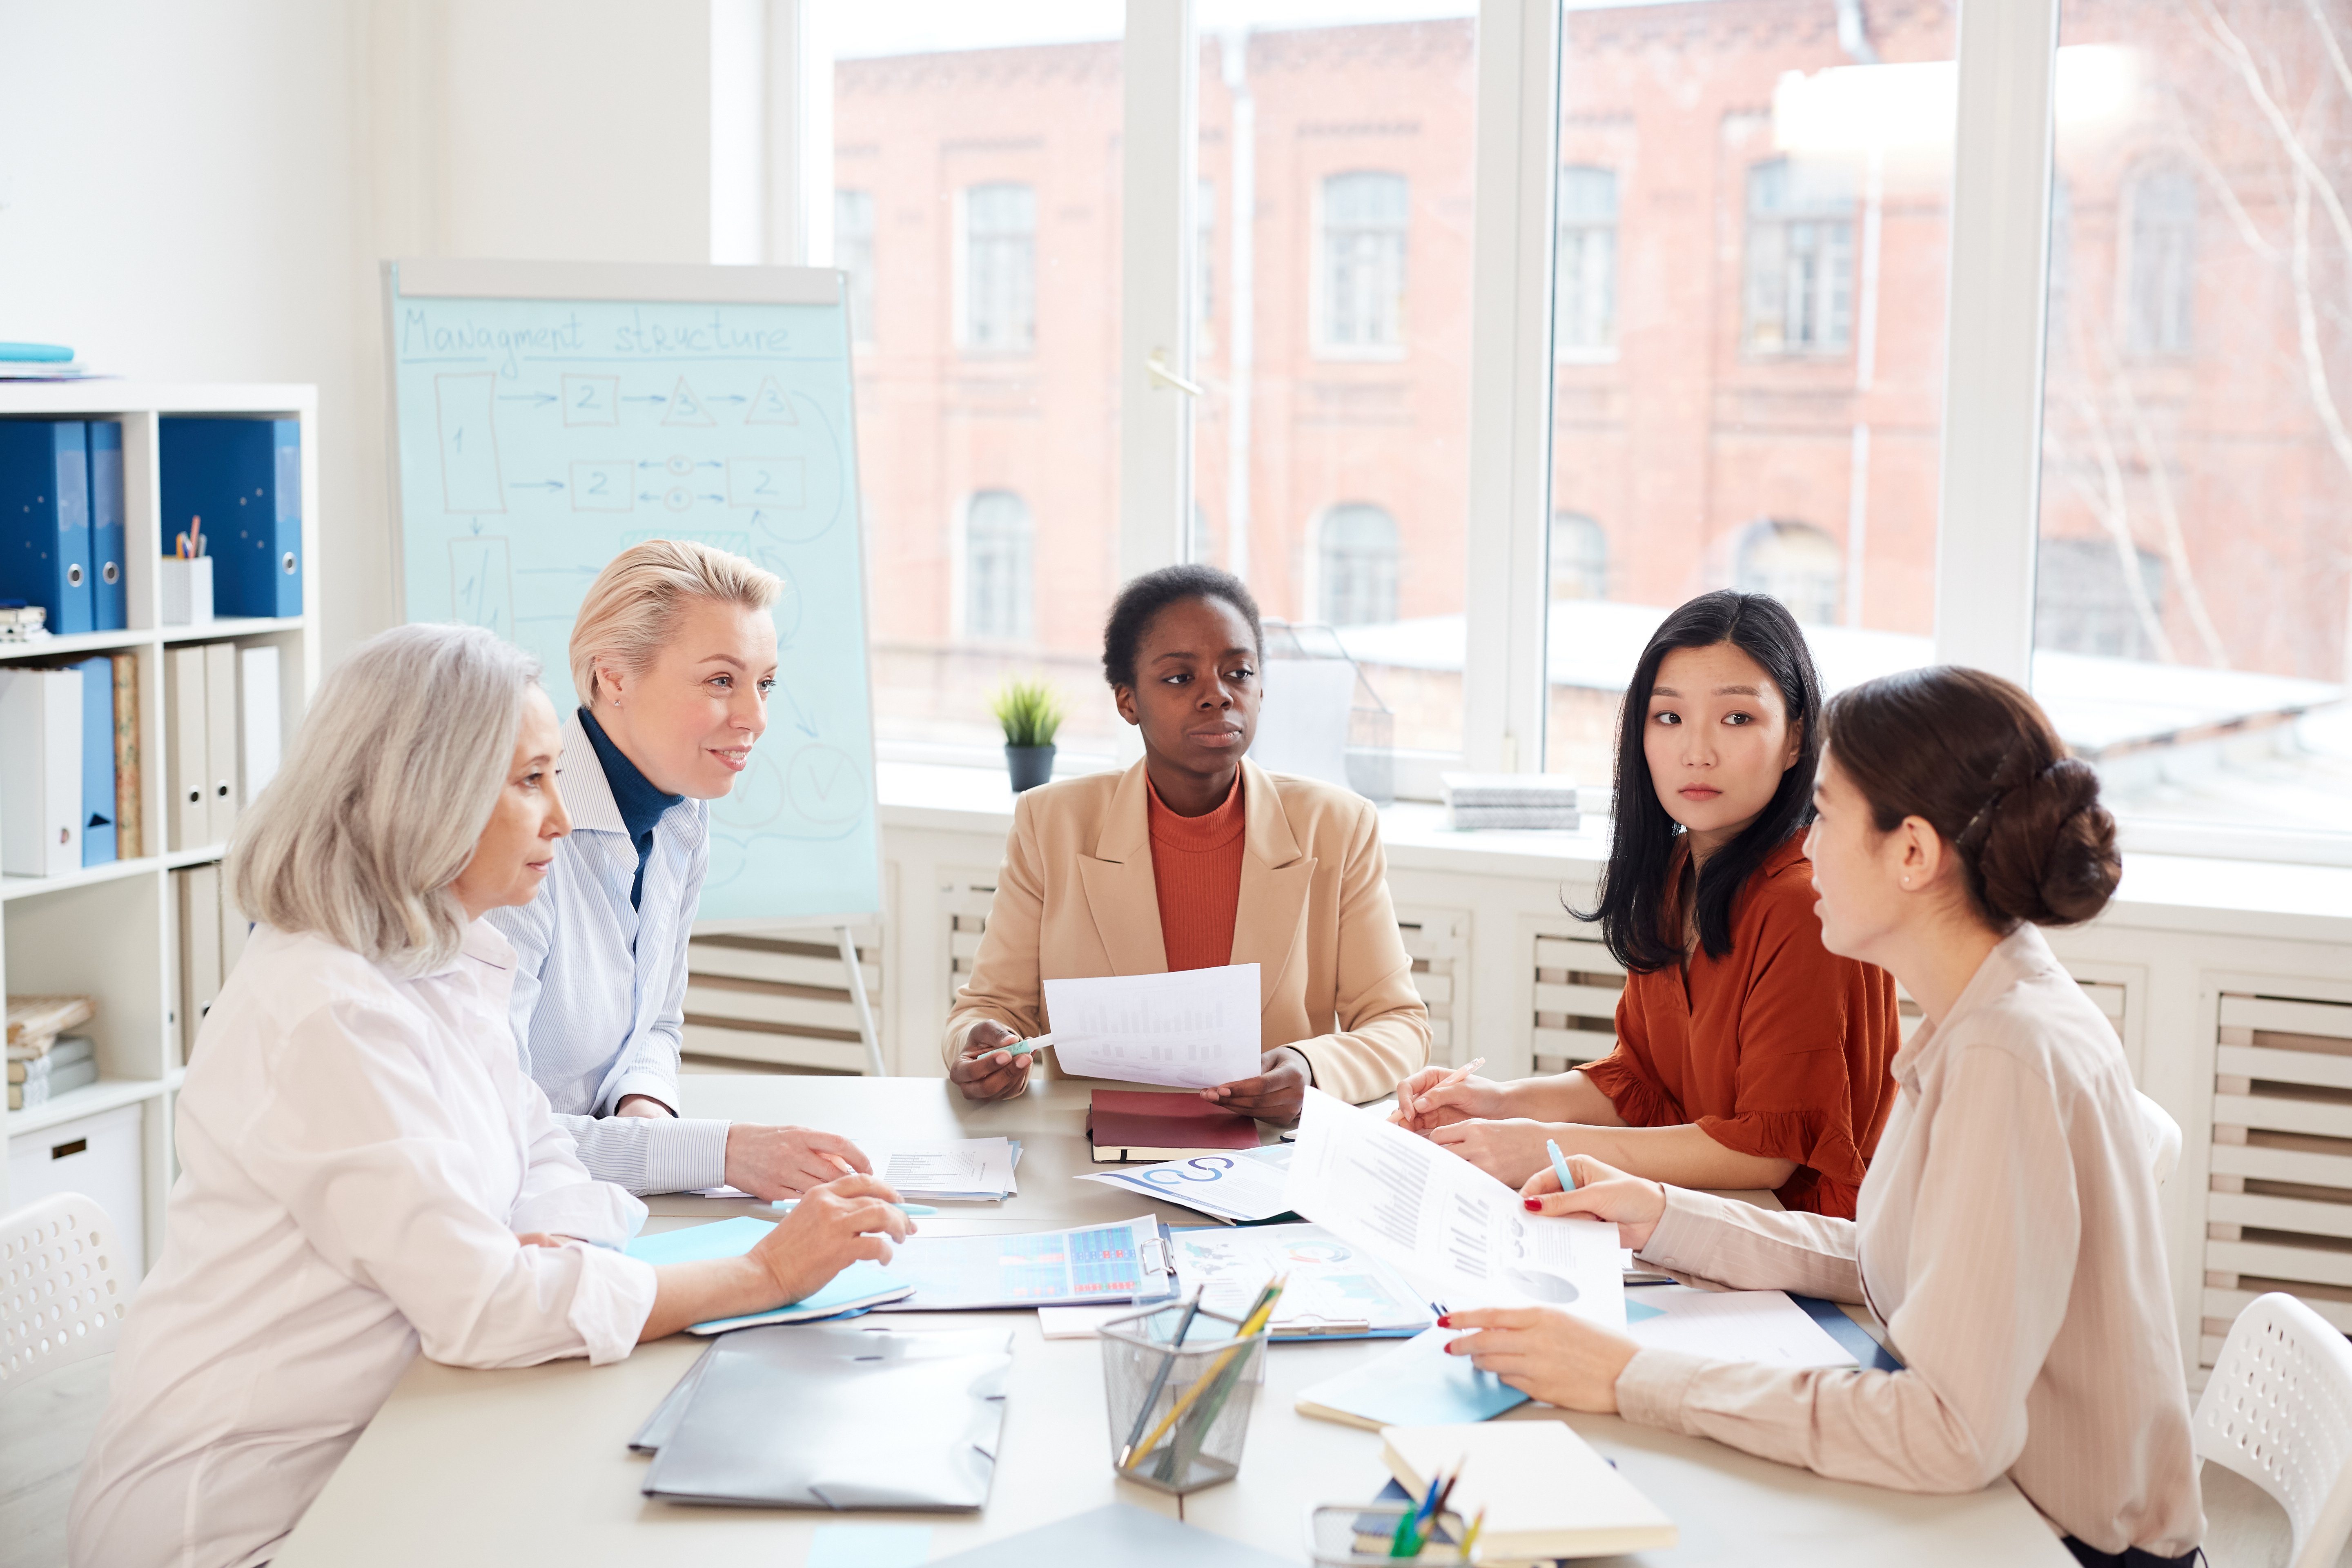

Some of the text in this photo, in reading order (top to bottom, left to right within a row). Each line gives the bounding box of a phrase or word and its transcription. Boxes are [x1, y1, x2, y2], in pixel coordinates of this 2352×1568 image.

[614, 306, 792, 354] structure
[575, 385, 602, 410] 2
[677, 393, 698, 416] 3
[766, 389, 785, 413] 3
[453, 425, 464, 454] 1
[587, 471, 609, 495] 2
[753, 470, 779, 495] 2
